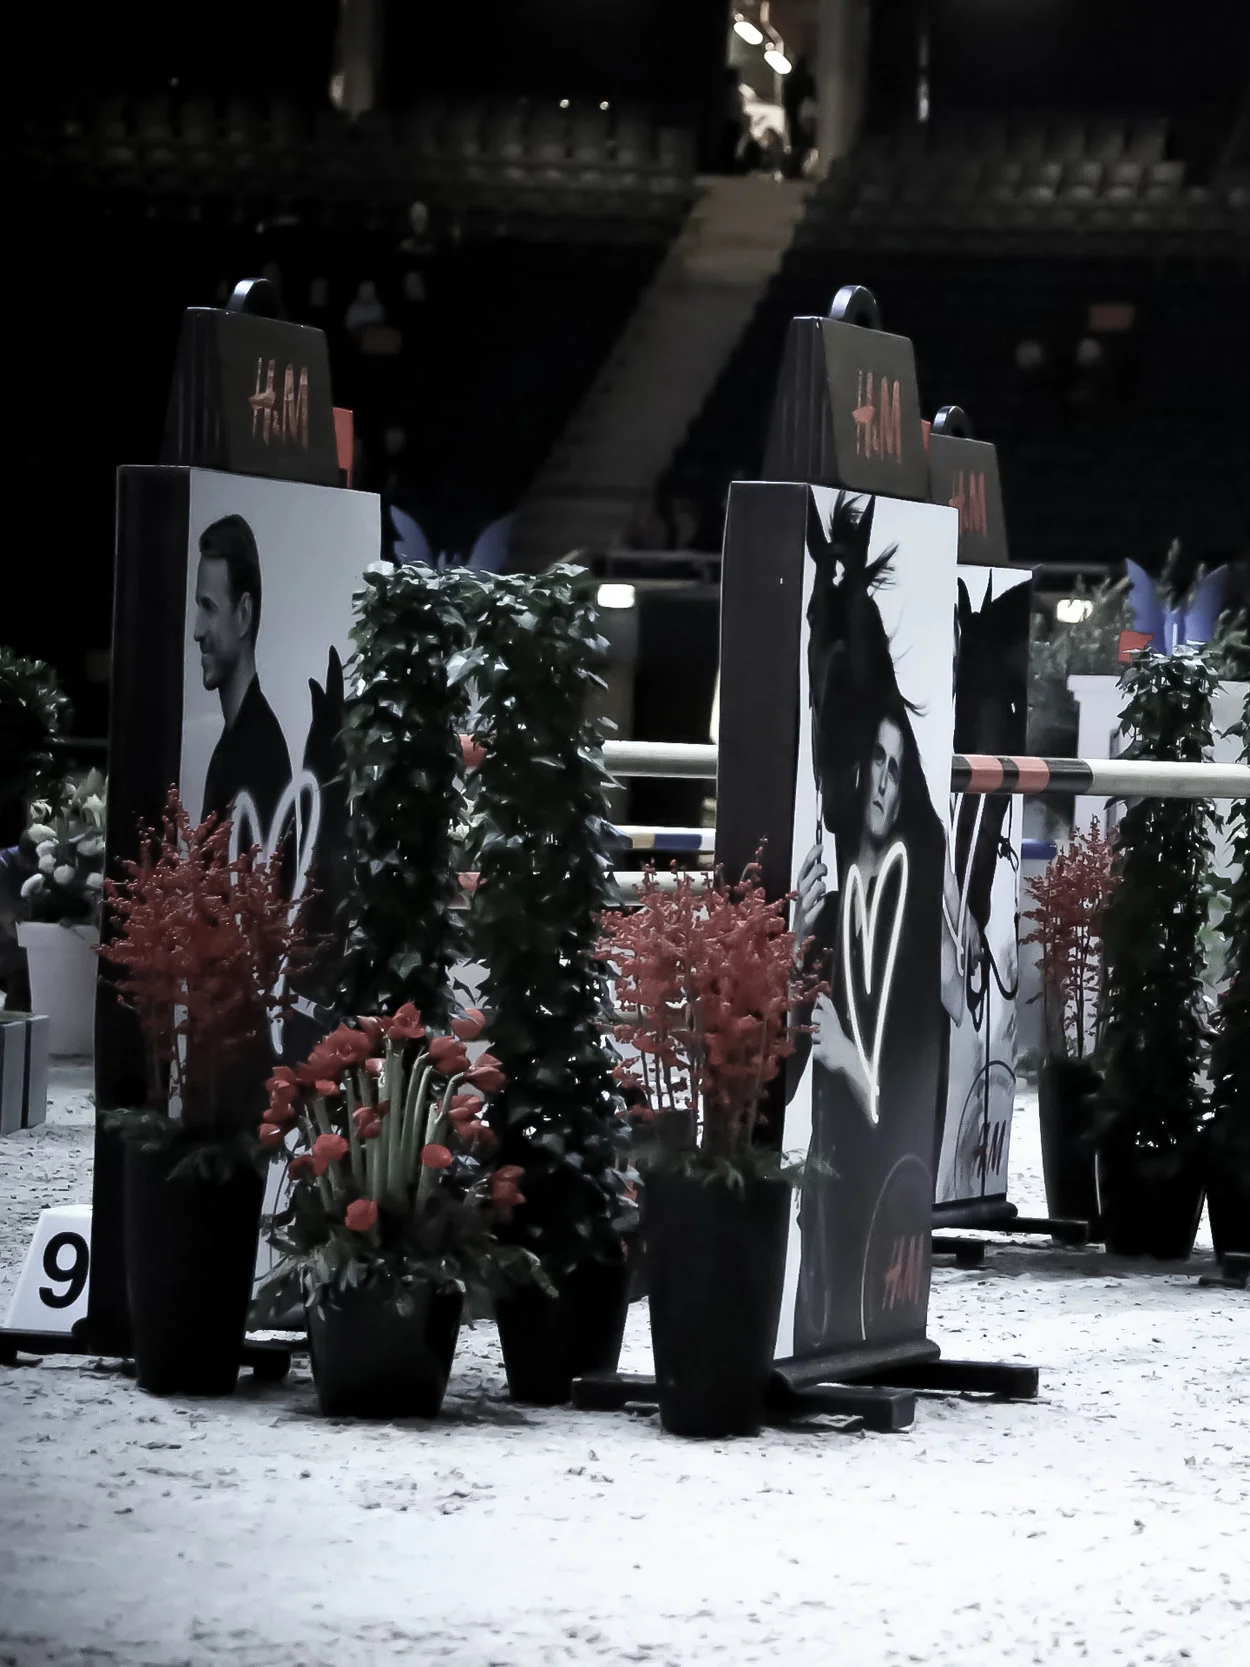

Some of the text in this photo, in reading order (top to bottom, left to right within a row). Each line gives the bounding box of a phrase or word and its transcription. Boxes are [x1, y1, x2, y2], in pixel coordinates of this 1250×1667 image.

[248, 357, 309, 453] H&M
[851, 370, 902, 464] H&M
[39, 1232, 89, 1309] 9
